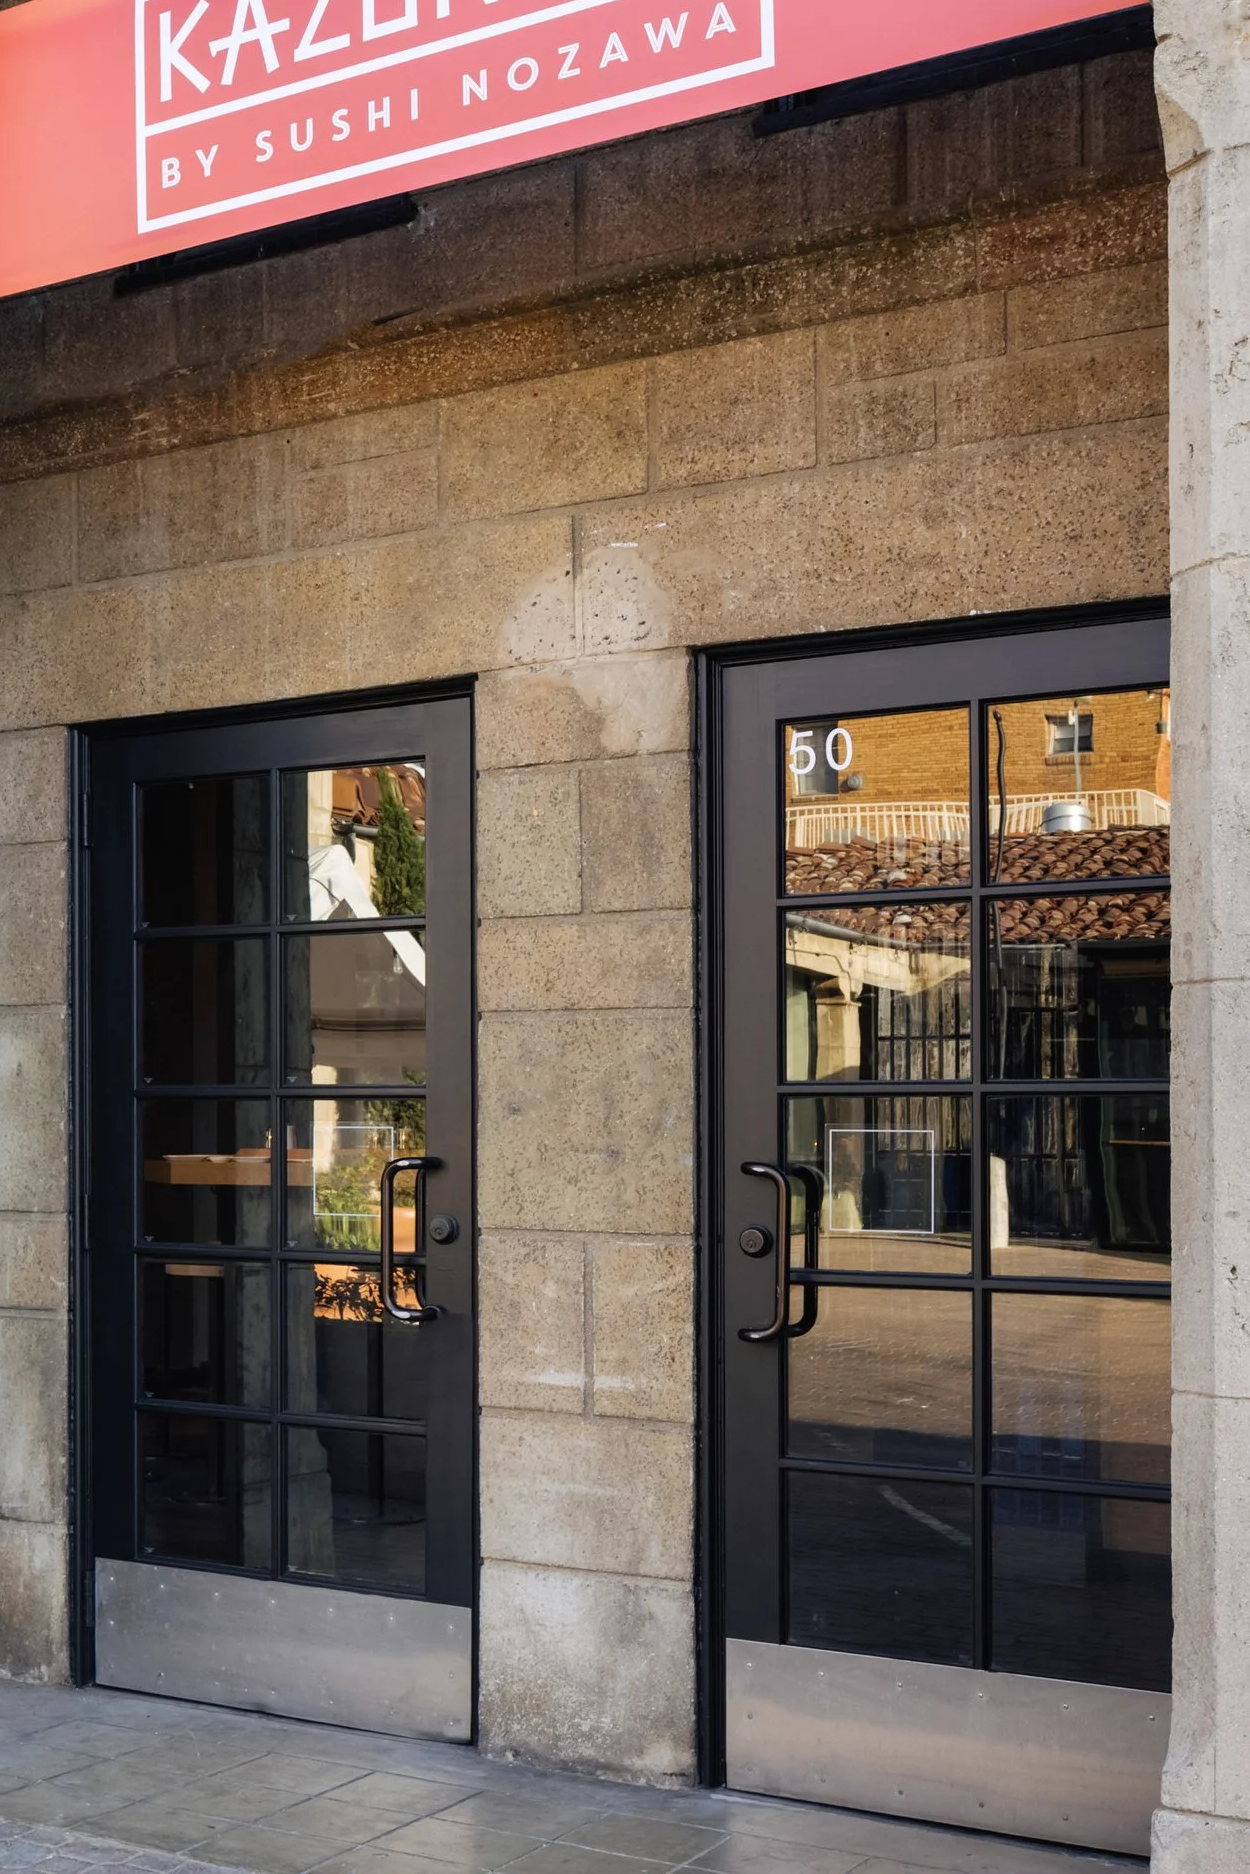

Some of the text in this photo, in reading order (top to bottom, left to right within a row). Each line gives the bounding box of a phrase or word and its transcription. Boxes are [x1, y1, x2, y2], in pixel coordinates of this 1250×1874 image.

[161, 1, 737, 190] BY SUSHI NOZAWA
[788, 727, 853, 775] 50
